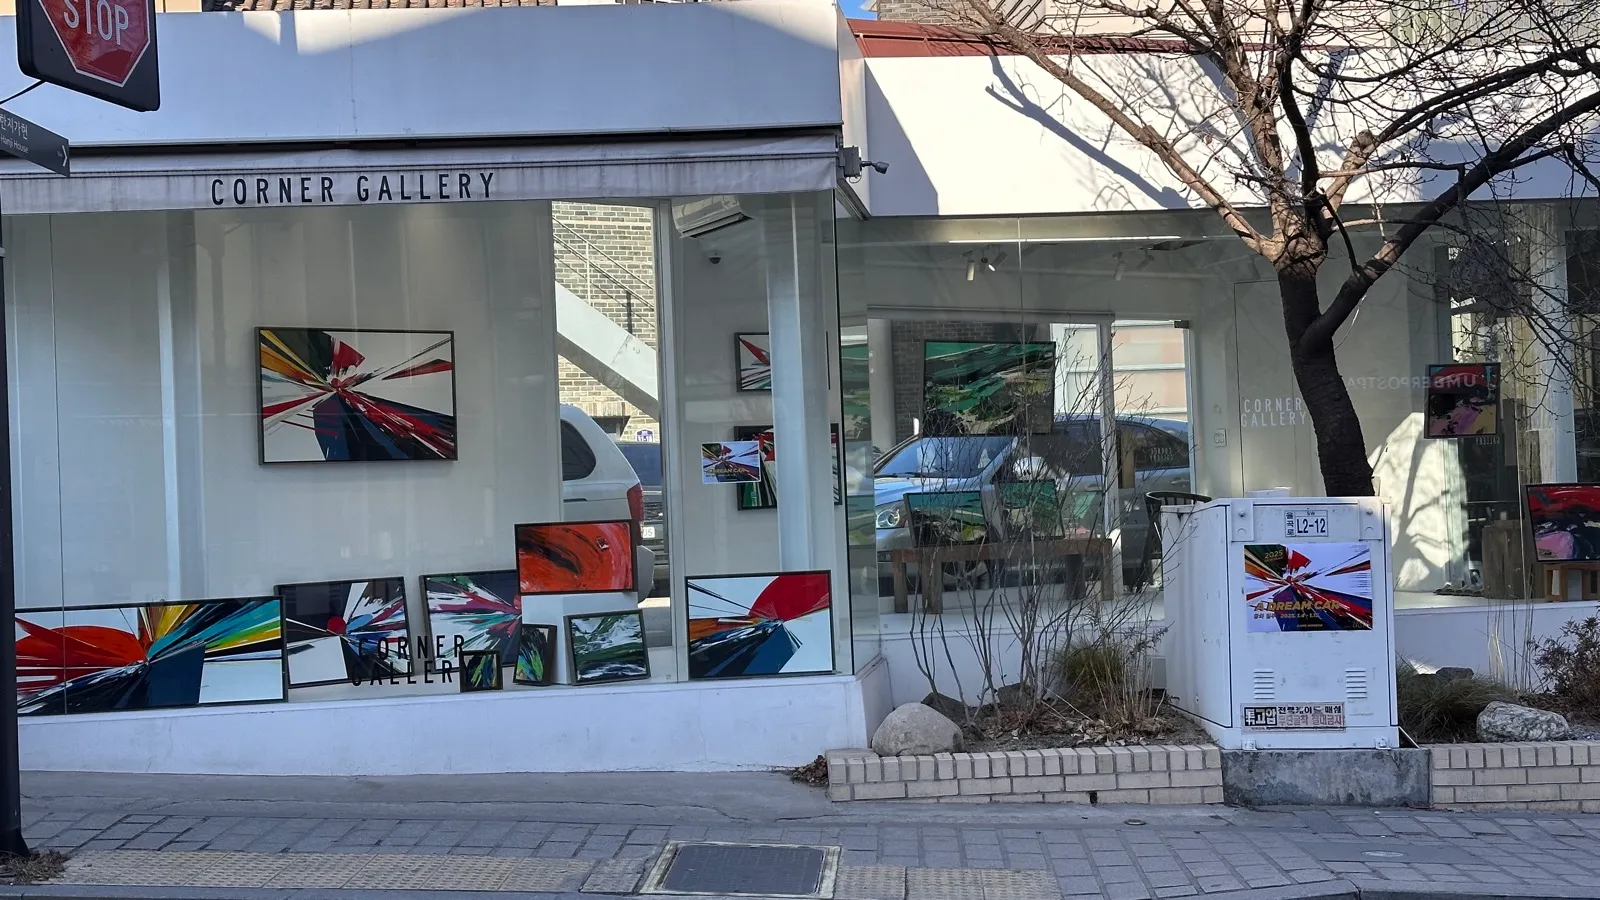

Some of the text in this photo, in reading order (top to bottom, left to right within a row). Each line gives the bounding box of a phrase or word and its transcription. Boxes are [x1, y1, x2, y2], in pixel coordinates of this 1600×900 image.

[64, 0, 129, 45] STOP
[211, 173, 494, 205] CORNER GALLERY
[1244, 397, 1302, 413] CORNER
[1240, 411, 1307, 427] GALLERY
[1296, 518, 1326, 533] L2-12
[1264, 549, 1284, 559] 2025
[1255, 600, 1341, 611] A DREAM CAR
[358, 634, 465, 661] CORNER
